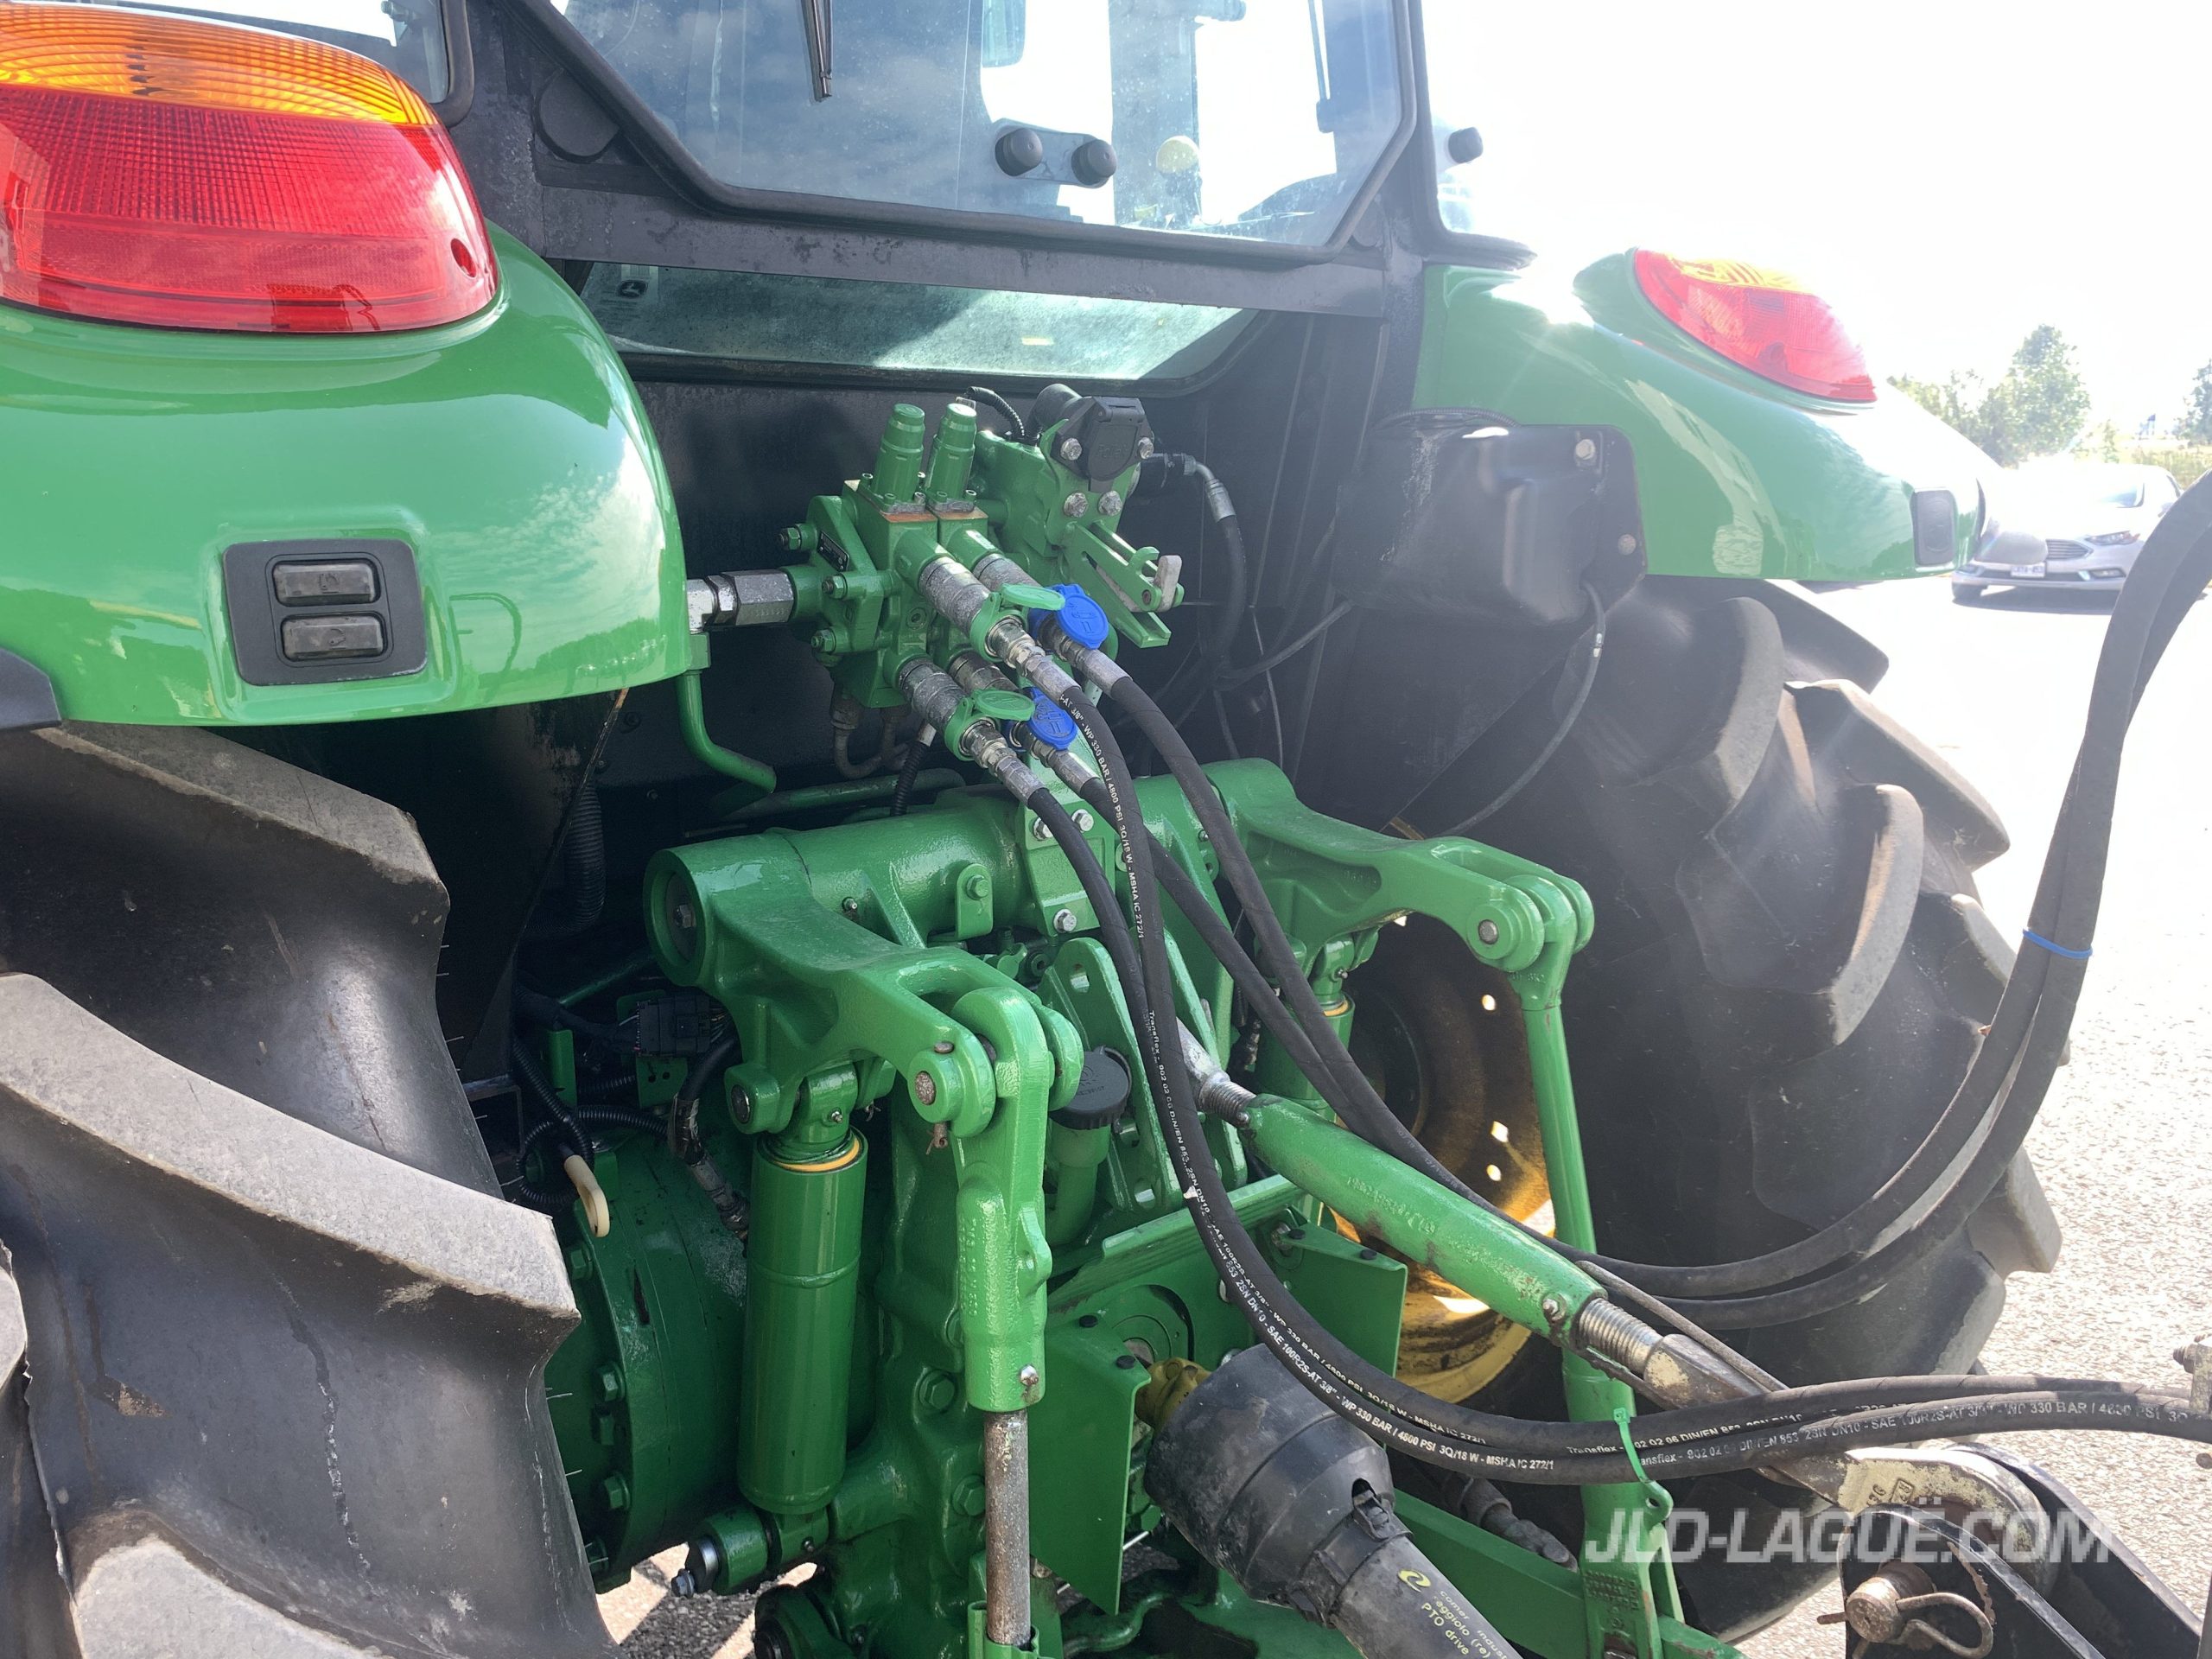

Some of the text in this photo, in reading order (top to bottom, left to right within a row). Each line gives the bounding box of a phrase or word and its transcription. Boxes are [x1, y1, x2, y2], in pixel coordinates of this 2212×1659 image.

[1084, 726, 1095, 739] WP
[1091, 740, 1102, 756] 330
[1098, 757, 1110, 778] BAR
[1108, 783, 1120, 804] 4800
[1114, 804, 1123, 822] PSI
[1126, 855, 1133, 863] W
[1128, 872, 1140, 901] MSHA
[1134, 902, 1141, 912] IC
[1149, 1010, 1160, 1054] Transflex
[1196, 1188, 1211, 1213] DN10
[1274, 1312, 1287, 1327] WP
[1287, 1327, 1301, 1343] 330
[1301, 1342, 1320, 1360] BAR
[1325, 1363, 1346, 1382] 4800
[1347, 1379, 1363, 1393] PSI
[1396, 1407, 1408, 1417] W
[1414, 1415, 1445, 1432] MSHA
[1446, 1427, 1459, 1436] IC
[1226, 1261, 1239, 1278] 853
[1236, 1280, 1251, 1299] 2SN
[1247, 1297, 1266, 1322] DN10
[1267, 1325, 1285, 1345] SAE
[1281, 1343, 1322, 1382] 100R2S-AT
[1341, 1396, 1357, 1411] WP
[1355, 1408, 1373, 1422] 330
[1371, 1416, 1393, 1435] BAR
[1397, 1431, 1418, 1446] 4800
[1420, 1439, 1436, 1452] PSI
[1439, 1445, 1468, 1460] 3Q/18
[1469, 1452, 1480, 1463] W
[1517, 1458, 1528, 1469] IC
[1529, 1459, 1554, 1470] 272/1
[1780, 1432, 1799, 1445] 853
[1871, 1415, 1897, 1430] SAE
[2031, 1402, 2052, 1414] 330
[2056, 1402, 2088, 1414] BAR
[1649, 1438, 1664, 1446] 02
[1665, 1435, 1680, 1445] 06
[1679, 1427, 1719, 1442] DIN/EN
[1440, 1591, 1470, 1619] comer
[1421, 1602, 1470, 1655] PTO drive
[1471, 1639, 1491, 1658] (re)
